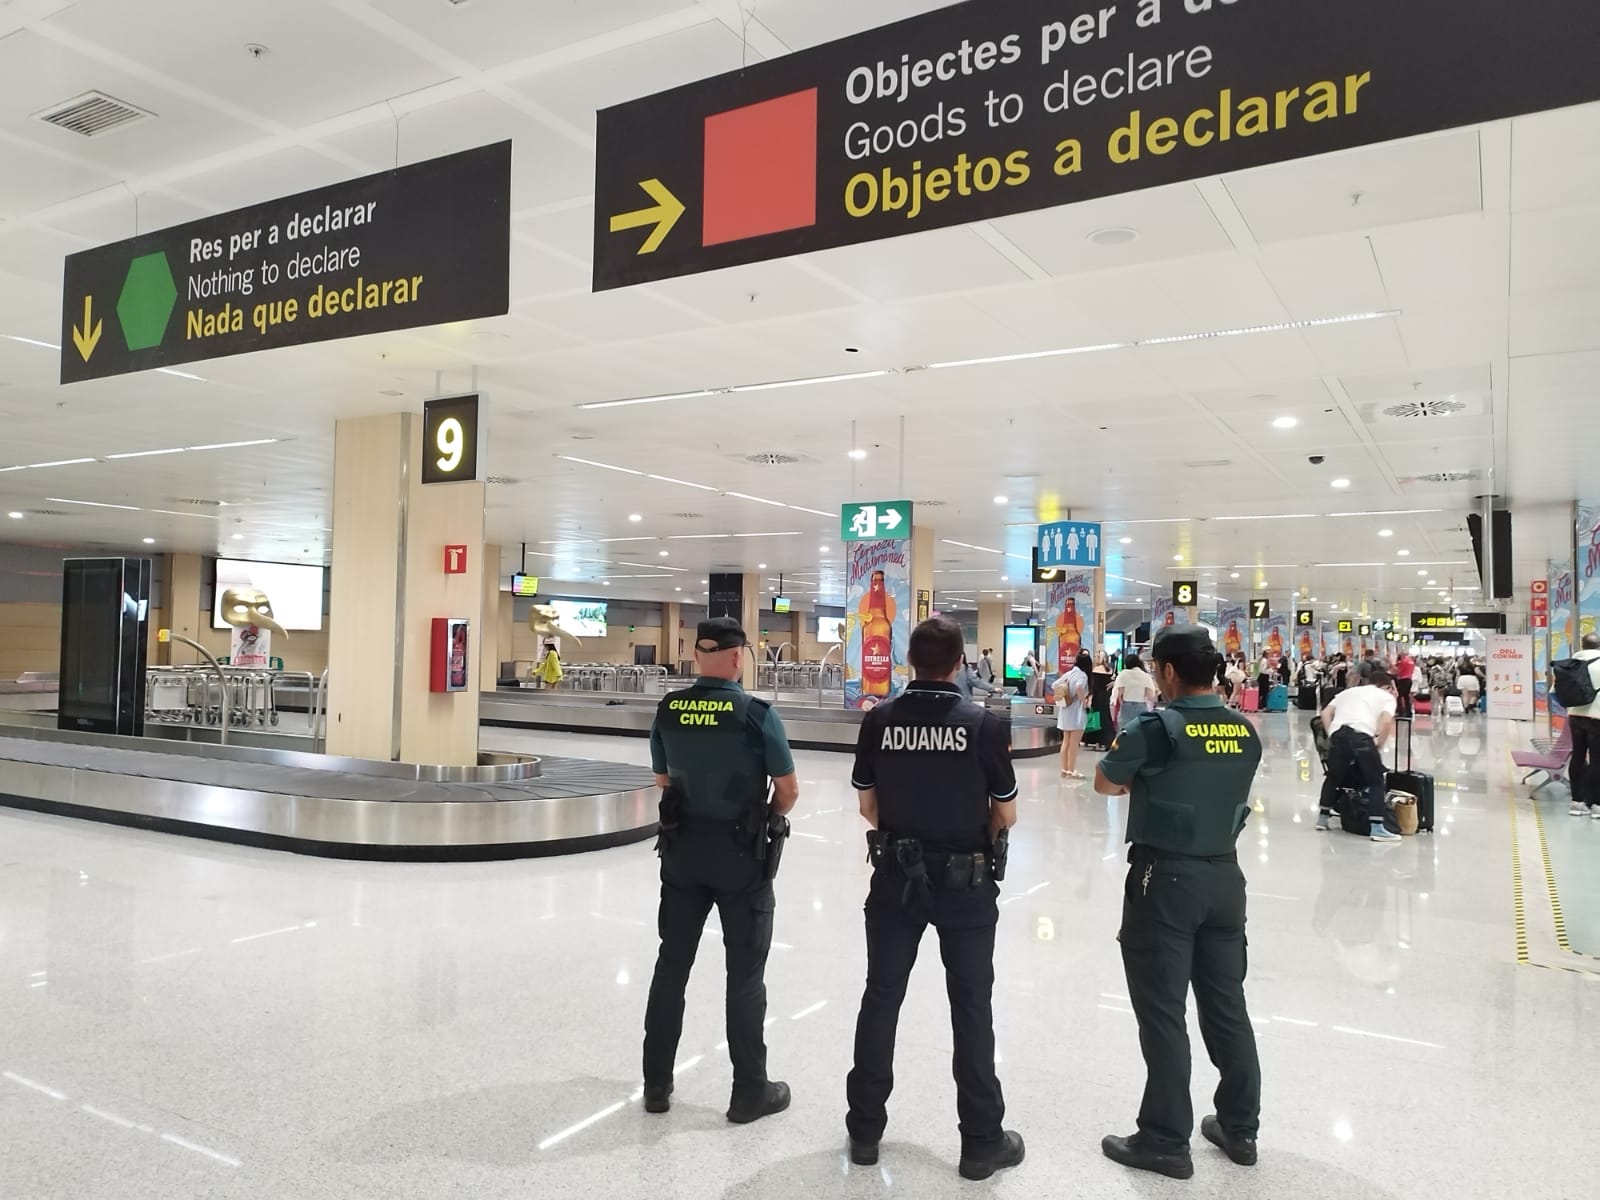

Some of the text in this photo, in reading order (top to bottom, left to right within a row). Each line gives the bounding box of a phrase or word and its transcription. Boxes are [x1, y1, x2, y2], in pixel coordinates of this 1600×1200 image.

[846, 0, 1161, 104] Objectes per a
[844, 45, 1213, 159] Goods to declare
[845, 72, 1371, 218] Objetos a declarar
[189, 201, 377, 263] Res per a declarar
[188, 247, 361, 301] Nothing to declare
[187, 275, 424, 340] Nada que declarar
[436, 417, 464, 472] 9
[1178, 585, 1192, 603] 8
[1254, 602, 1266, 617] 7
[1301, 612, 1310, 624] 6
[669, 700, 734, 712] GUARDIA
[680, 713, 719, 726] CIVIL
[1185, 723, 1250, 737] GUARDIA
[881, 726, 967, 752] ADUANAS
[1205, 740, 1243, 753] CIVIL
